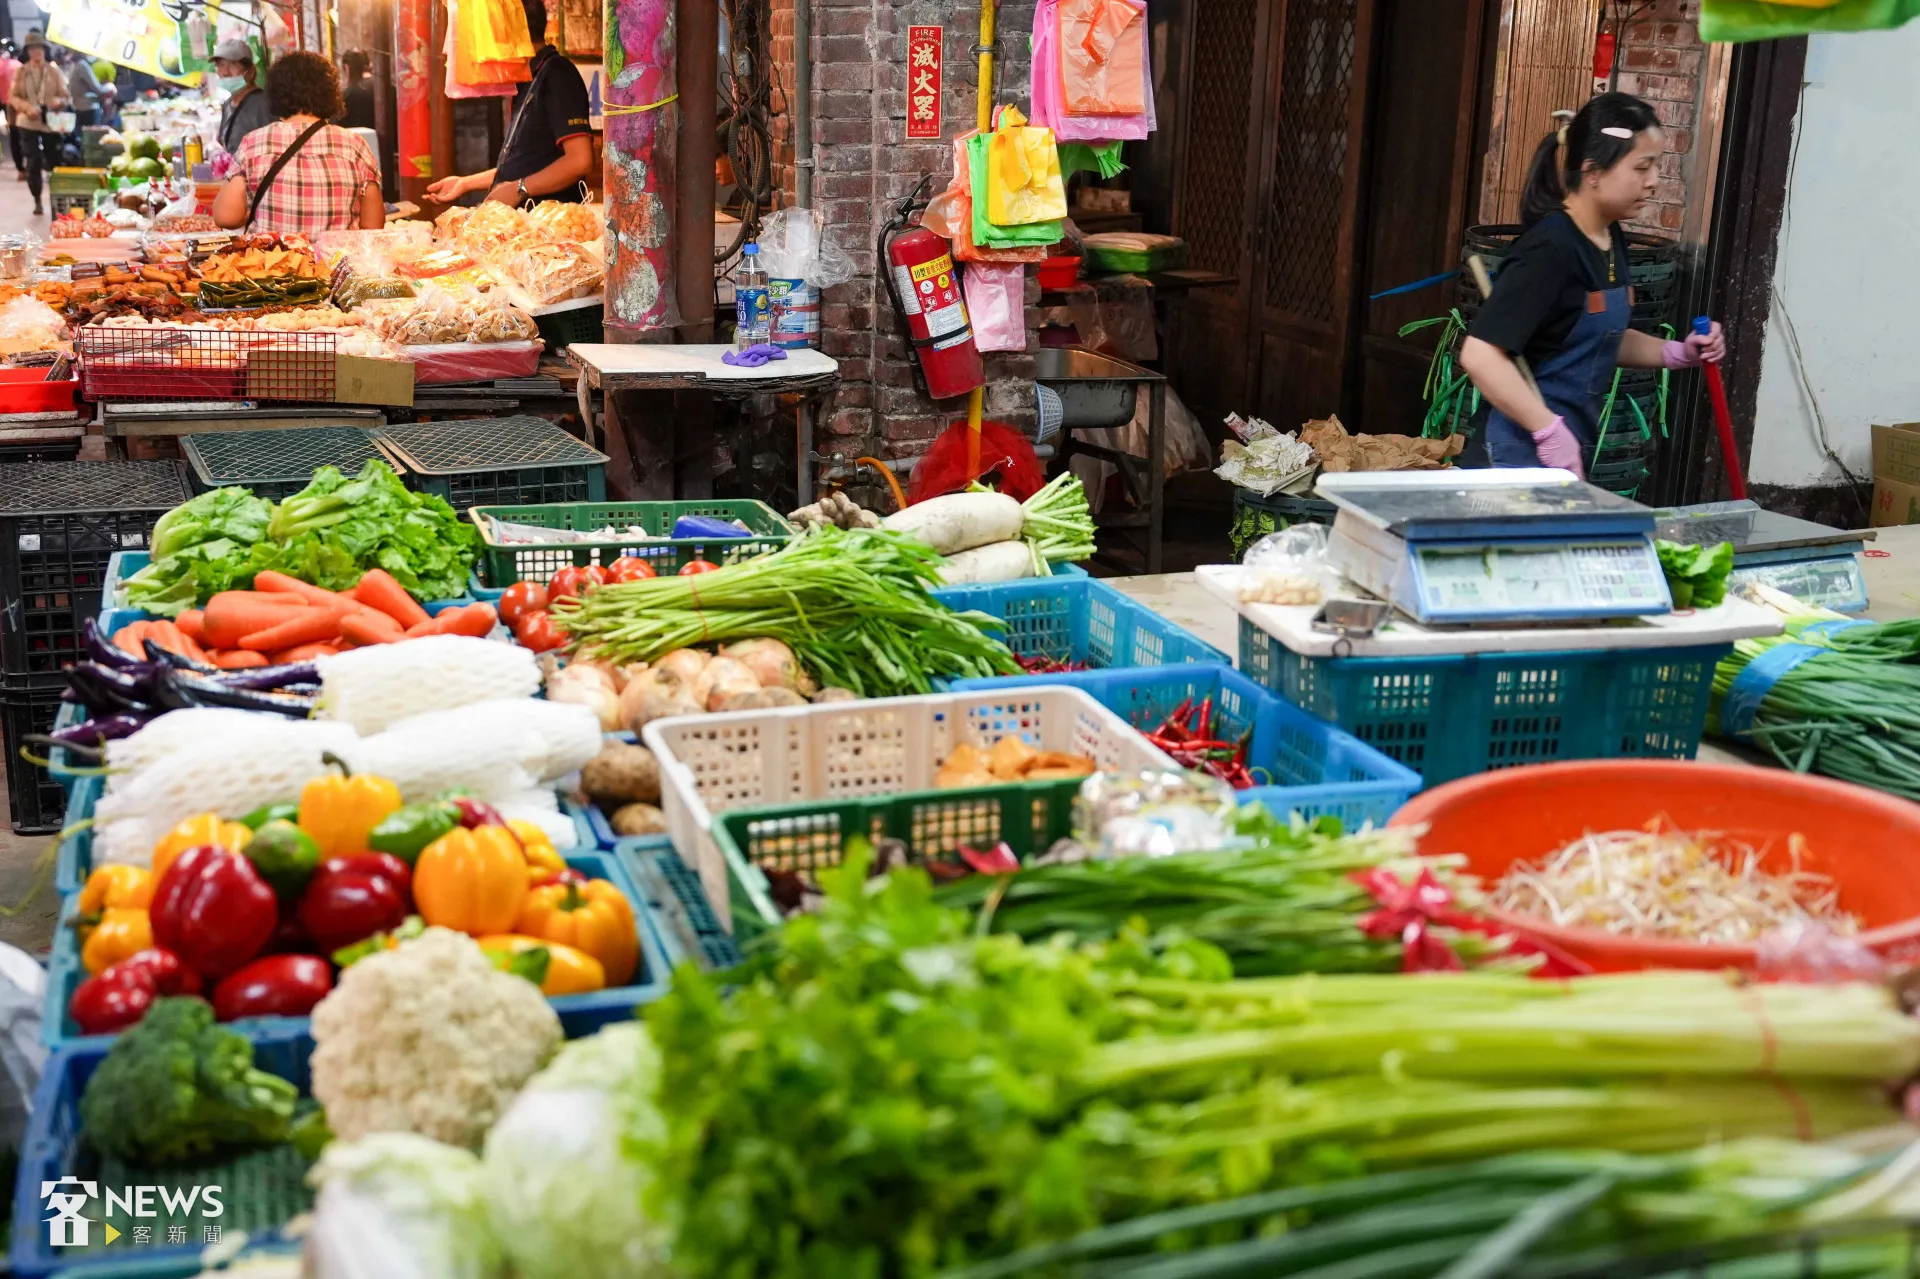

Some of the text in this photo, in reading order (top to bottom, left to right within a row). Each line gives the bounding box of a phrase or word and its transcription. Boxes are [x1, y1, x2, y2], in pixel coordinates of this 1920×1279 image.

[915, 28, 935, 37] FIRE
[910, 37, 941, 47] EXTINGUISHER
[911, 43, 938, 120] 滅火器
